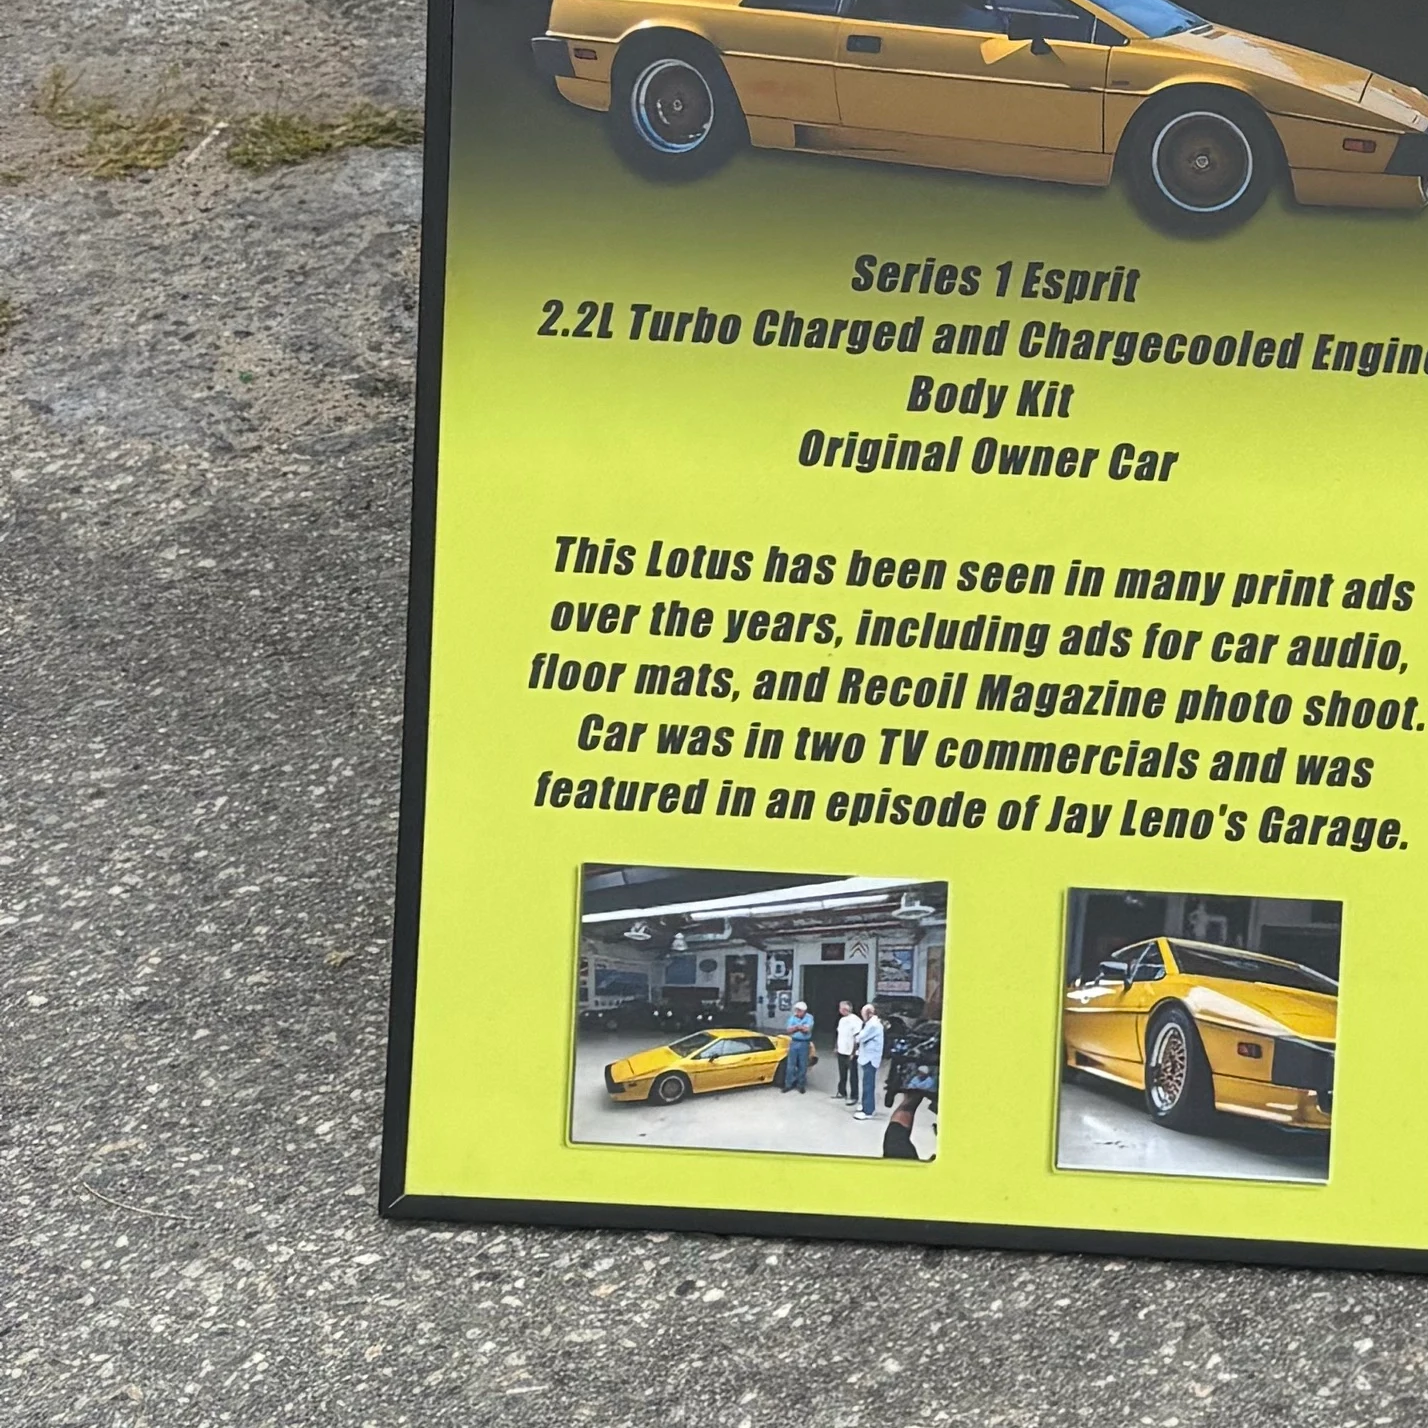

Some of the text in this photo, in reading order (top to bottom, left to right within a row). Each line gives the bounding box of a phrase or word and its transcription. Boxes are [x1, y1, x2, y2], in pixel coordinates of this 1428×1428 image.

[851, 254, 1141, 304] Series 1 Esprit
[536, 299, 614, 339] 2.2L
[629, 303, 742, 345] Turbo
[752, 309, 925, 355] Charged
[932, 319, 1010, 356] and
[1018, 320, 1305, 369] Chargecooled
[906, 375, 1075, 419] Body Kit
[798, 429, 1180, 482] Original Owner Car
[554, 535, 1416, 612] This Lotus has been seen in many print ads
[550, 600, 1408, 675] over the years, including ads for car audio,
[528, 652, 1425, 732] floor mats, and Recoil Magazine photo shoot.
[577, 713, 1375, 789] Car was in two TV commercials and was
[534, 770, 1408, 853] featured in an episode of Jay Leno's Garage.
